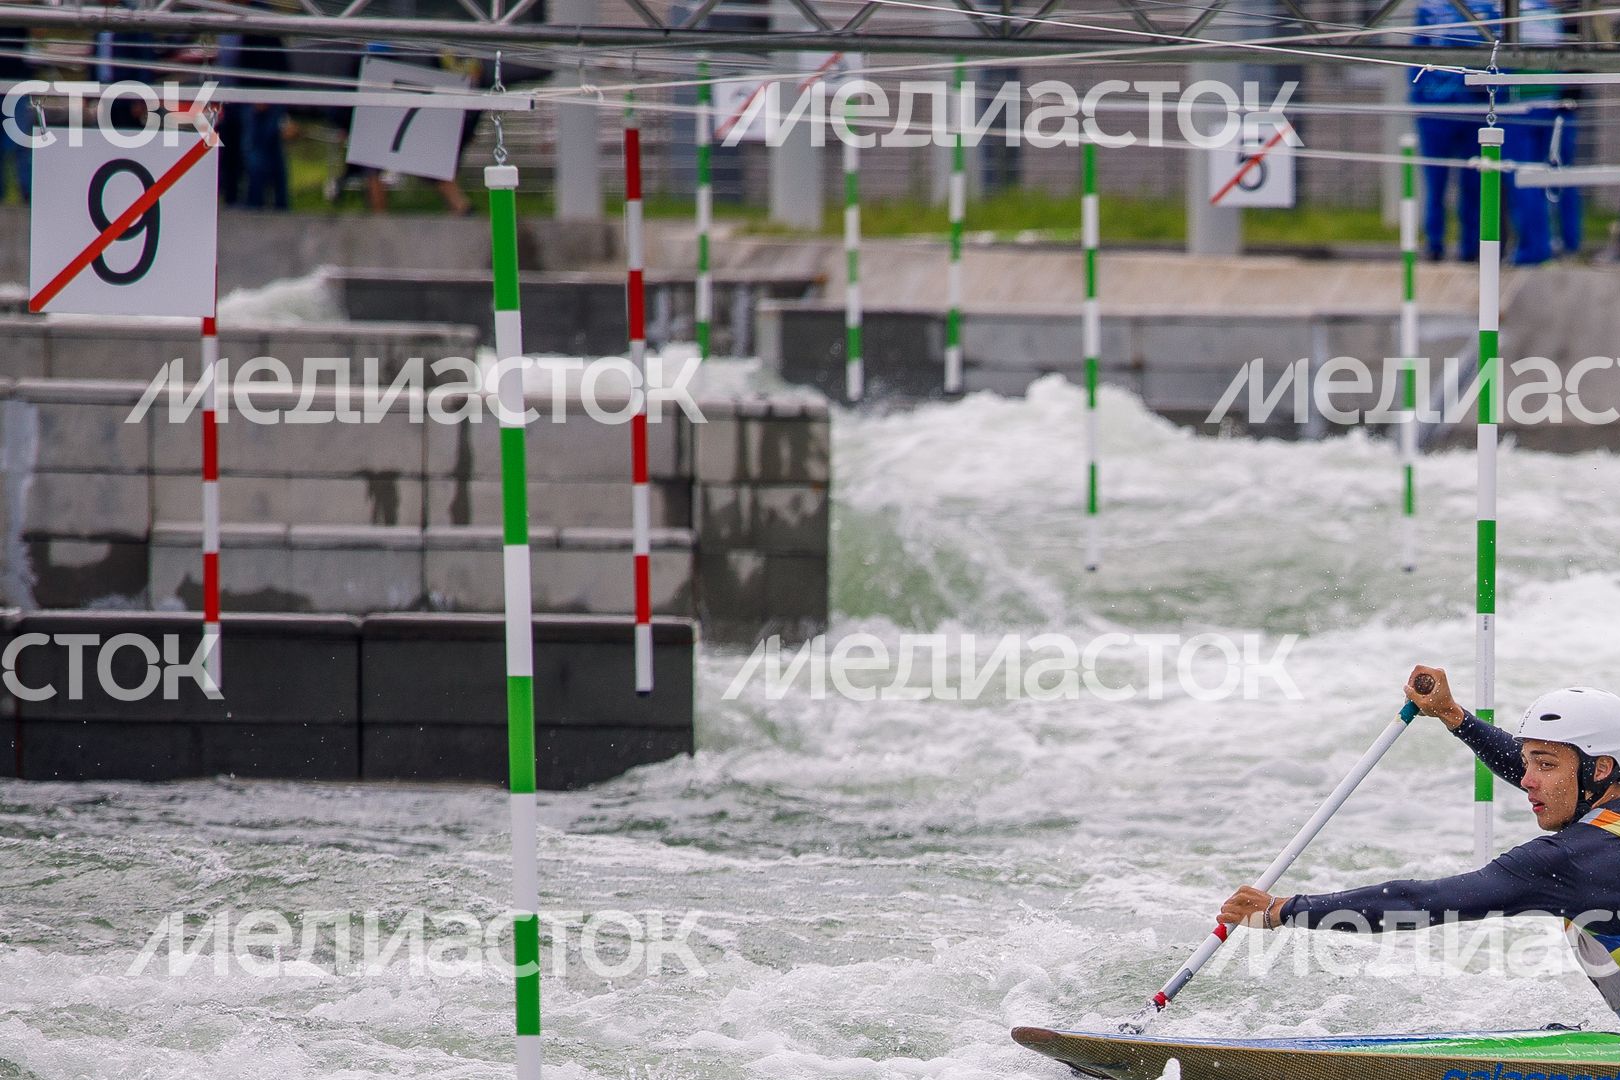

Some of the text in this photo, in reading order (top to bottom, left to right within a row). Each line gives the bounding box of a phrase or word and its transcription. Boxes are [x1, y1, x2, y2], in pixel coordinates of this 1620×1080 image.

[391, 79, 437, 153] 7
[1236, 137, 1268, 192] 5
[88, 158, 161, 286] 9
